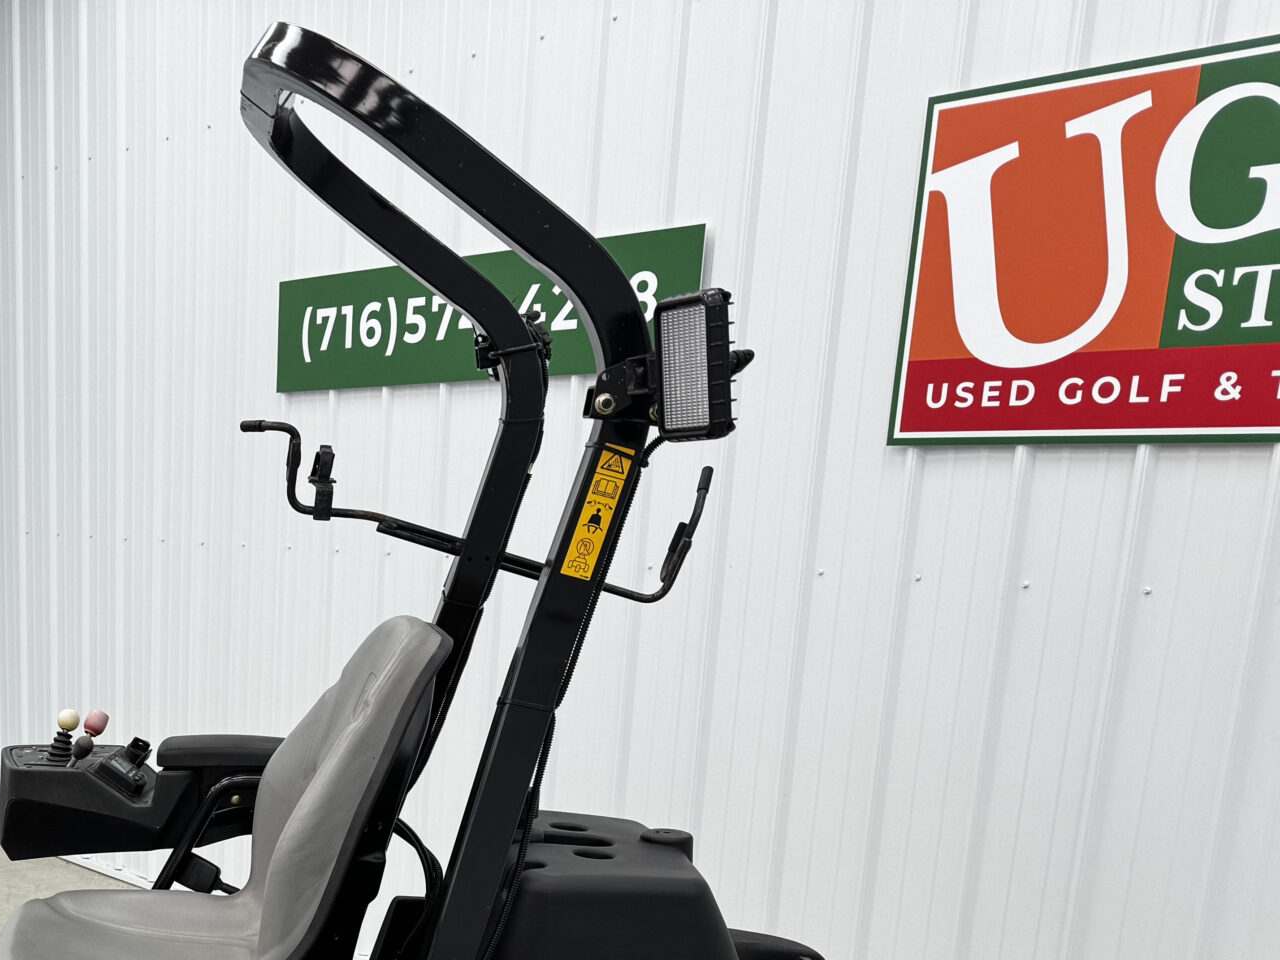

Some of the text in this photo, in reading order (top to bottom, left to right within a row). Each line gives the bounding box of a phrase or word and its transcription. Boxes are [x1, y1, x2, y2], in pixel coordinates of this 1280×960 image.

[925, 380, 1036, 408] USED
[1058, 373, 1185, 404] GOLF
[1214, 371, 1242, 401] &
